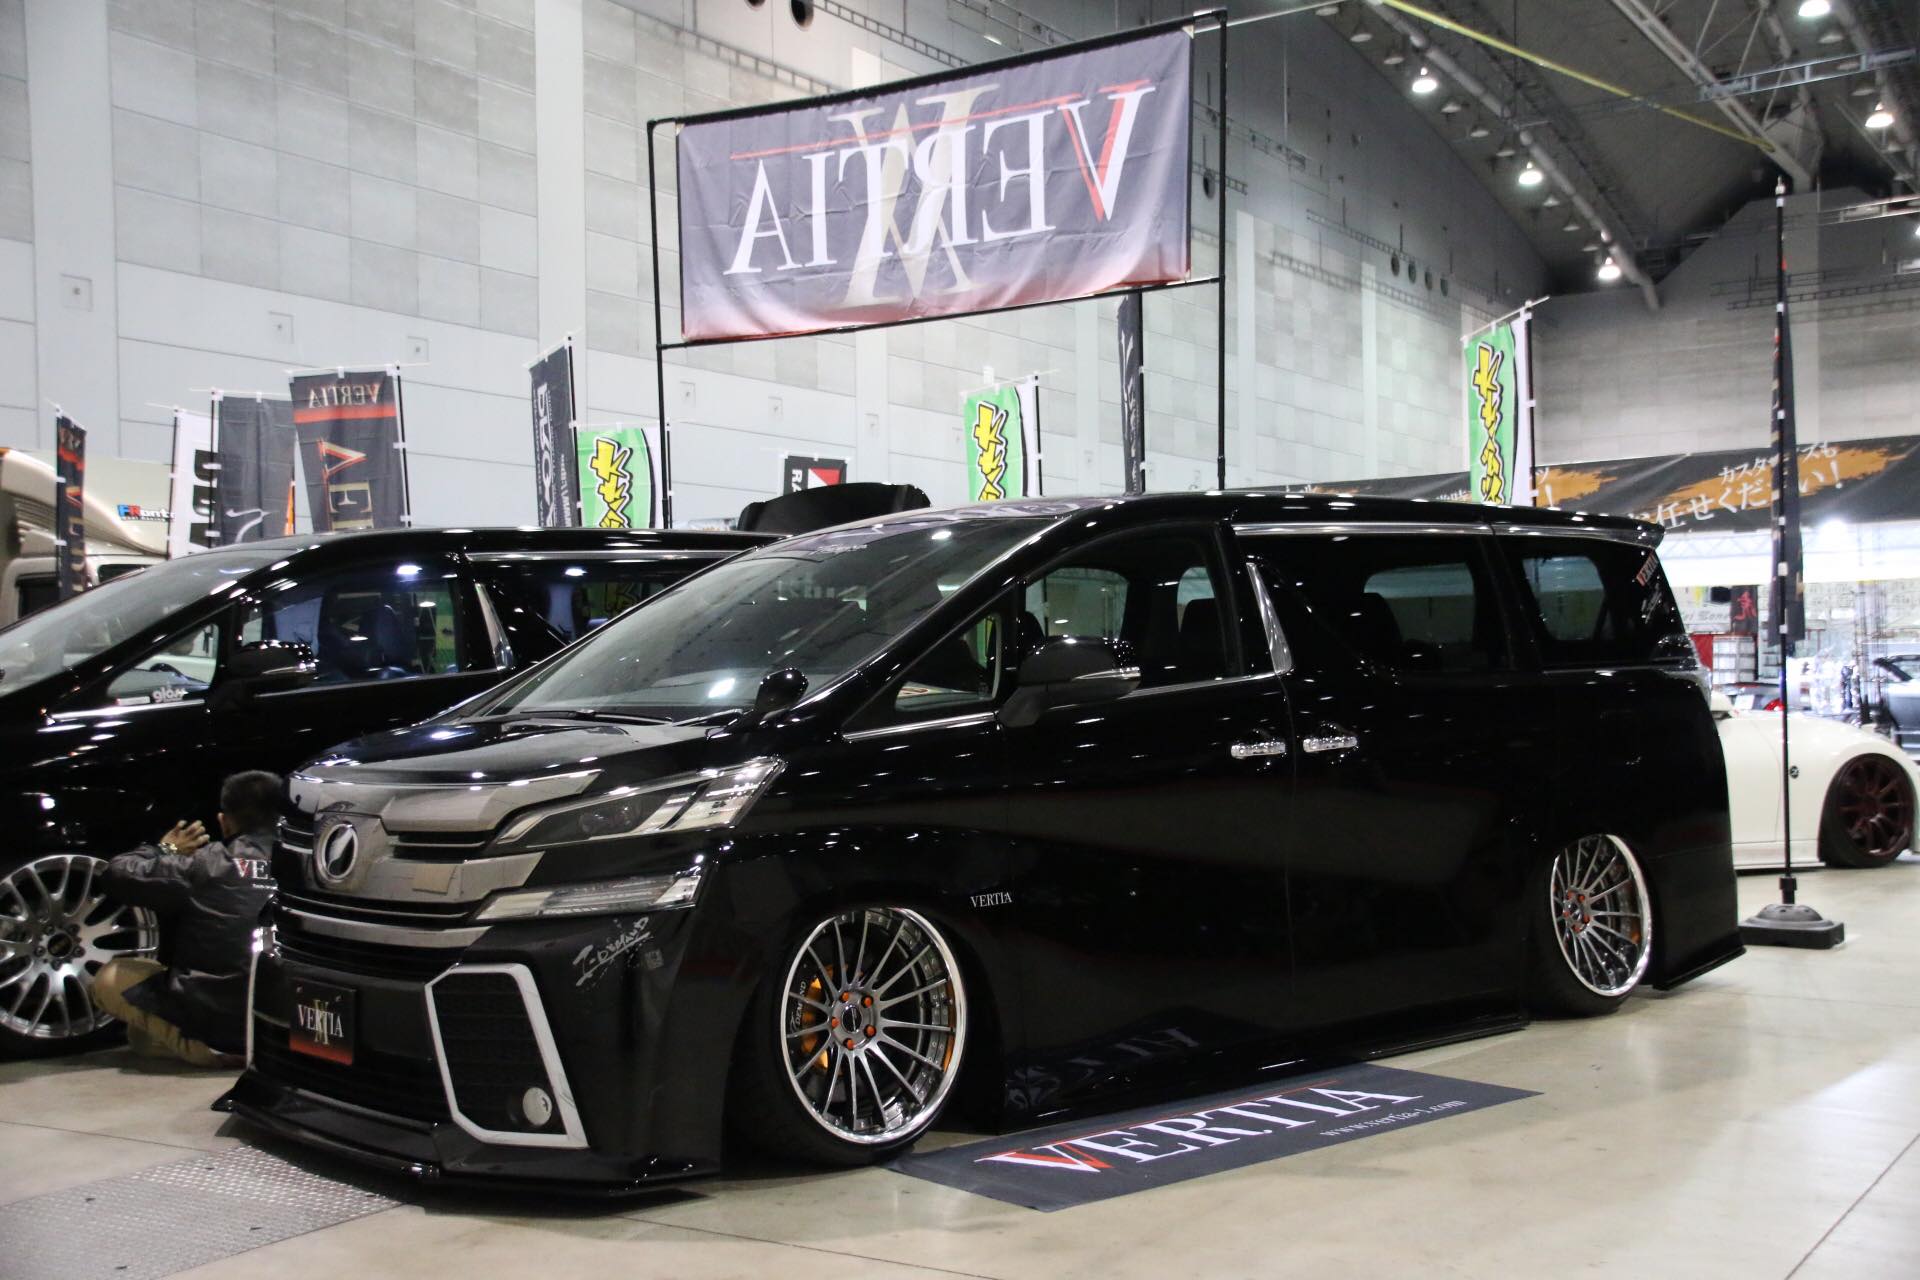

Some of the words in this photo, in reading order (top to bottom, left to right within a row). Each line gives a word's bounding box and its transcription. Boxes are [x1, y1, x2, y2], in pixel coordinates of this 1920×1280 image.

[232, 857, 273, 880] VE
[969, 891, 1013, 908] VERTIA
[297, 1003, 344, 1038] VERTIA
[973, 1086, 1425, 1173] VERTIA
